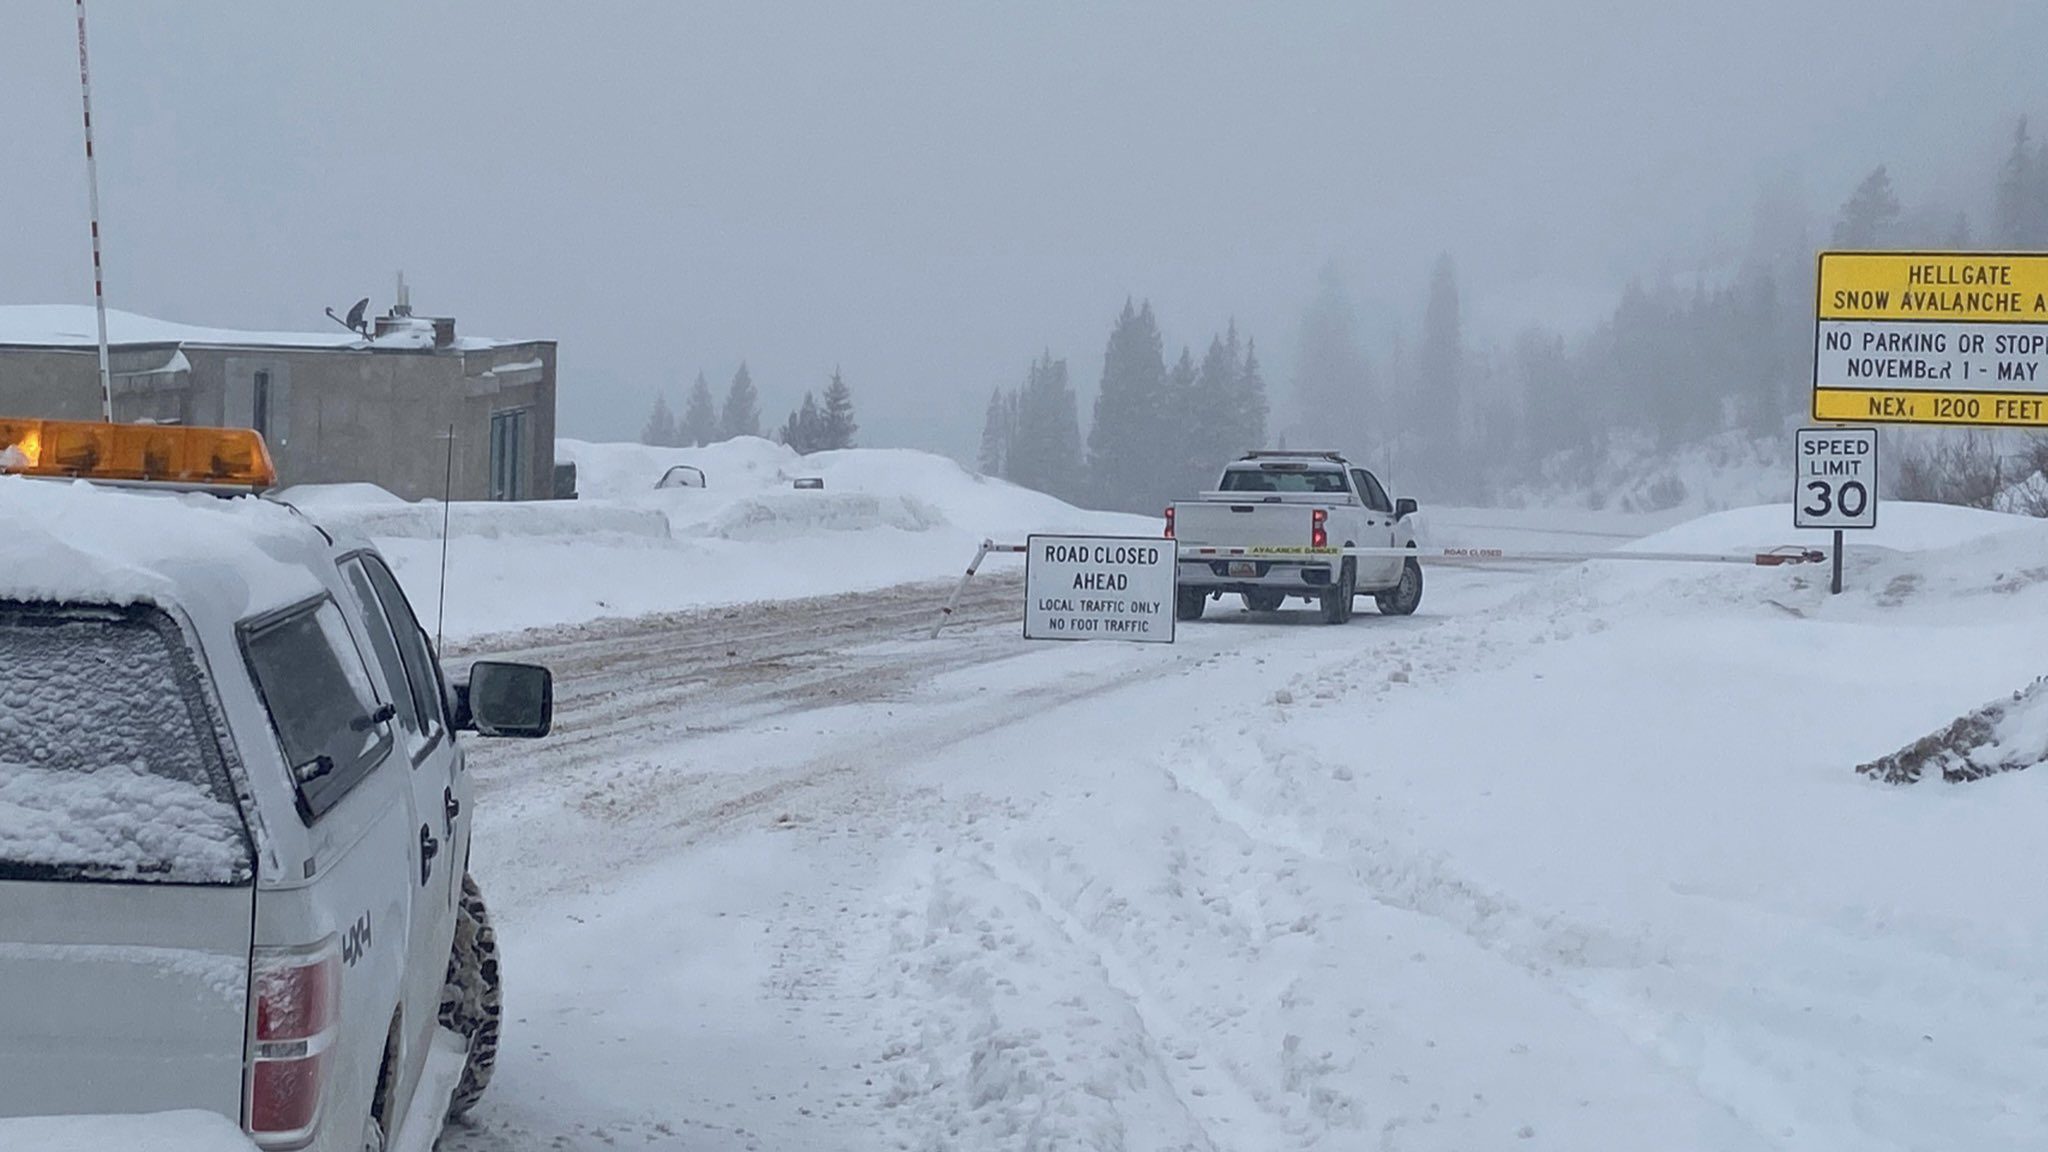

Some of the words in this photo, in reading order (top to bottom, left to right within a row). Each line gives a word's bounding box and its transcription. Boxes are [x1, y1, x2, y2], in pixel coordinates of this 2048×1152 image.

[1909, 265, 2011, 285] HELLGATE
[1834, 291, 1890, 310] SNOW
[1901, 293, 2022, 312] AVALANCHE
[1826, 332, 1852, 351] NO
[1863, 333, 1946, 353] PARKING
[1959, 334, 1984, 353] OR
[1995, 335, 2048, 354] STOP
[1963, 362, 1969, 379] 1
[1998, 362, 2038, 381] MAY
[1869, 398, 1914, 416] NEX
[1934, 399, 1980, 418] 1200
[1995, 400, 2042, 419] FEET
[1804, 440, 1869, 455] SPEED
[1811, 461, 1861, 475] LIMIT
[1803, 481, 1867, 517] 30
[1045, 546, 1089, 562] ROAD
[1095, 547, 1159, 564] CLOSED
[1073, 573, 1127, 590] AHEAD
[1039, 599, 1074, 611] LOCAL
[1080, 600, 1124, 612] TRAFFIC
[1131, 602, 1160, 613] ONLY
[1049, 618, 1065, 630] NO
[1071, 619, 1098, 631] FOOT
[1104, 620, 1149, 632] TRAFFIC
